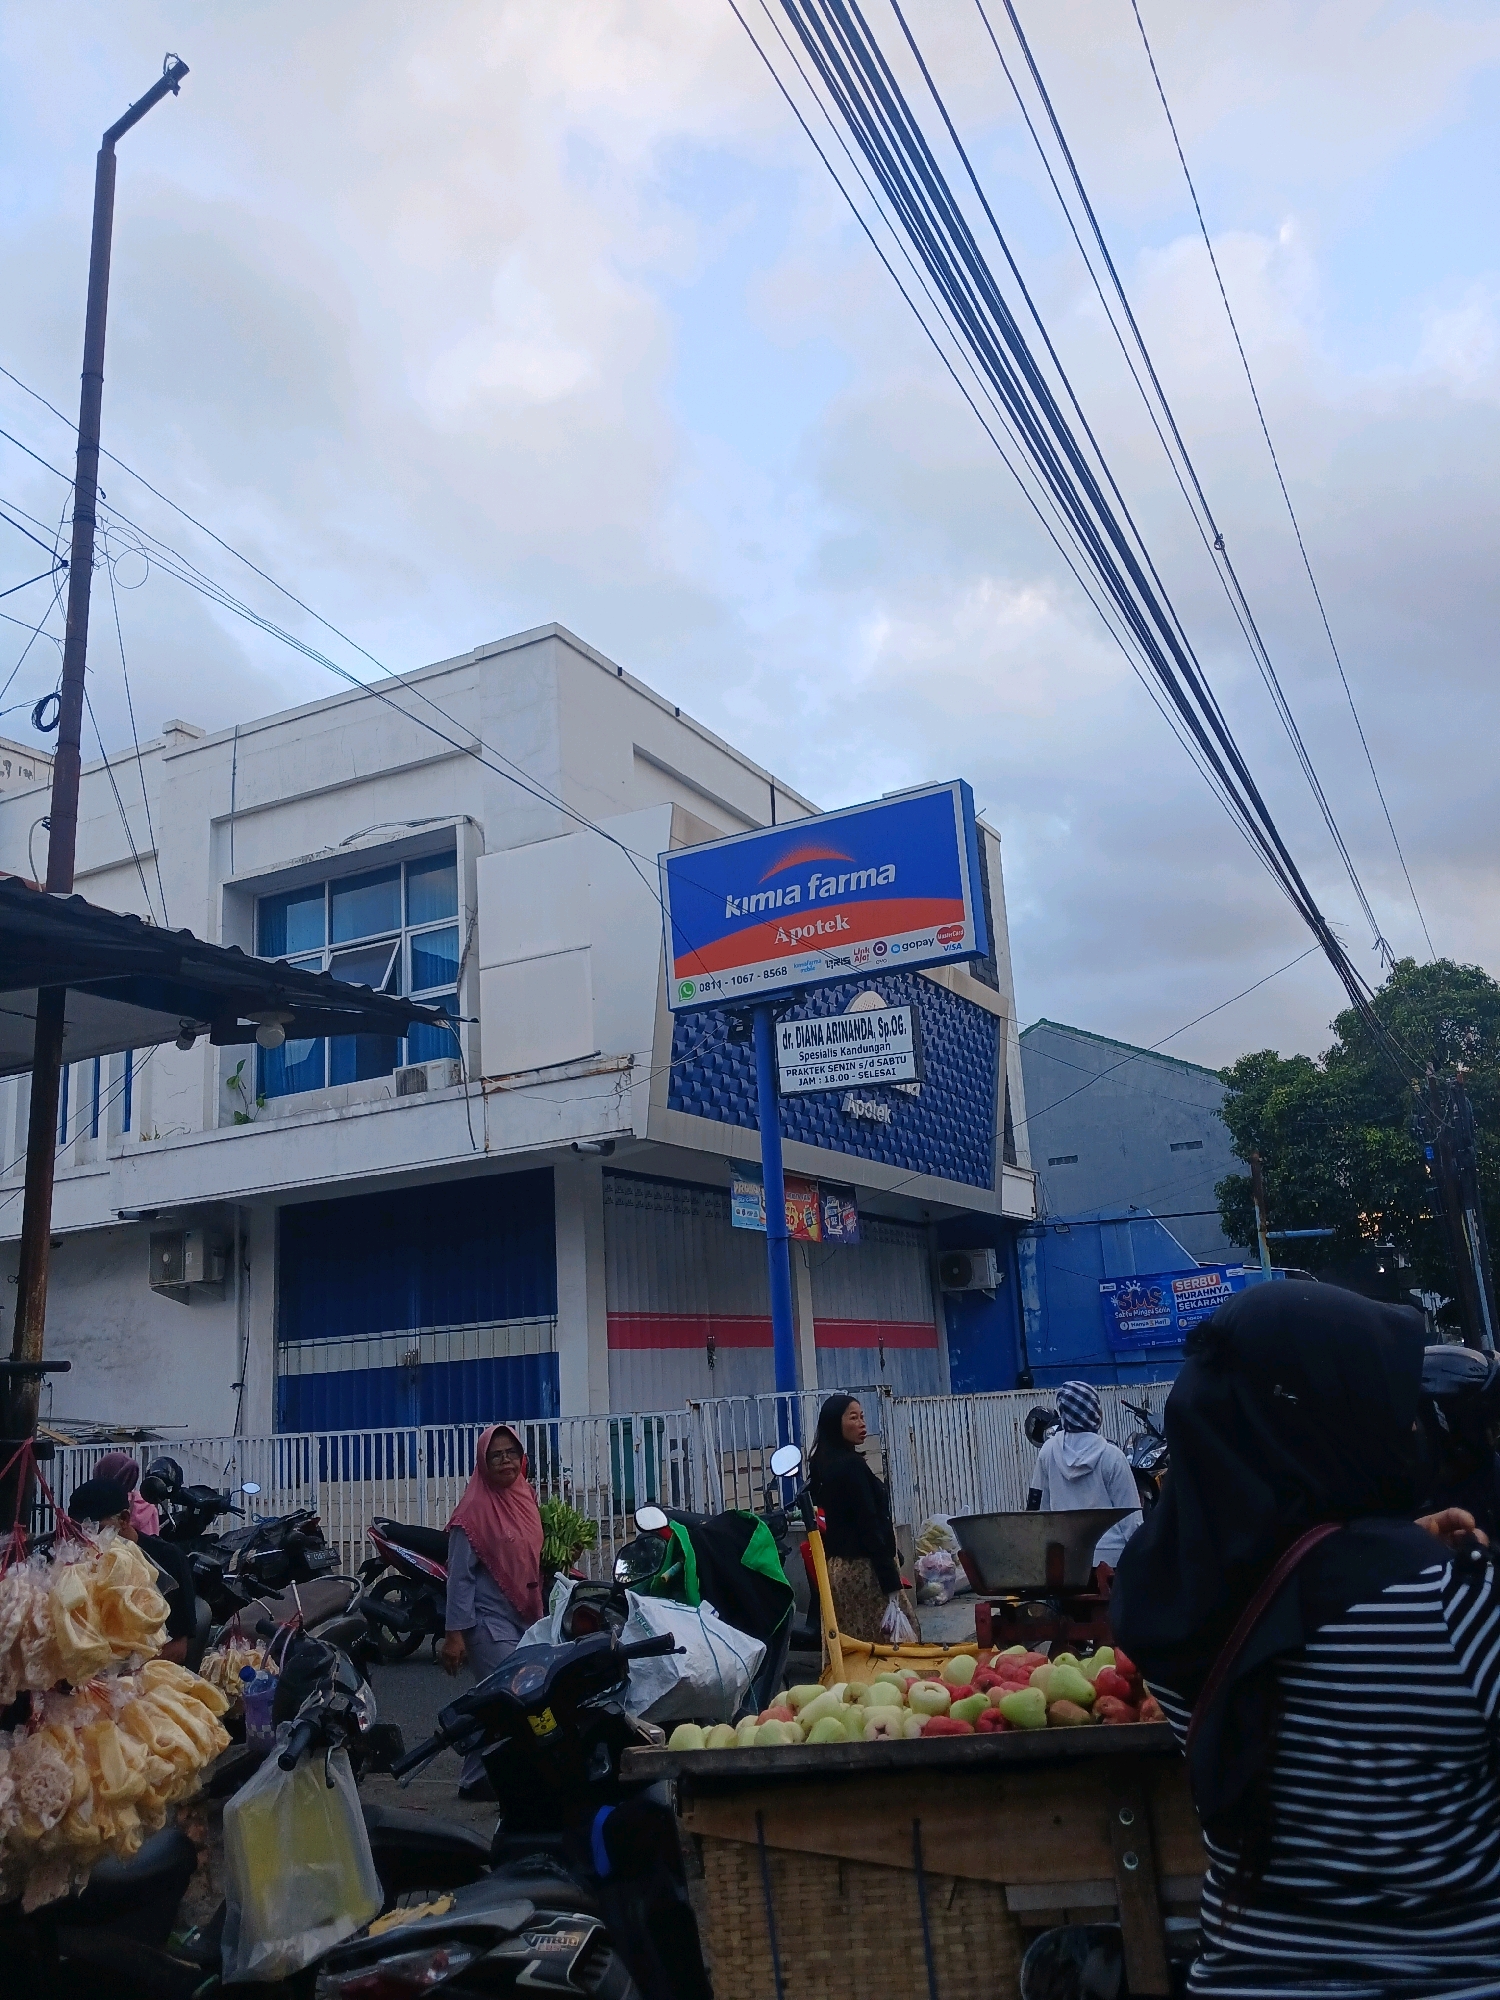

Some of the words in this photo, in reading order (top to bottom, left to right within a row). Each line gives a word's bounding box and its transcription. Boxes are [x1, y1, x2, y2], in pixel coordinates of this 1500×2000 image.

[808, 864, 896, 900] farma
[774, 914, 850, 946] Apotek
[901, 937, 935, 952] gopay
[943, 943, 963, 952] VISA
[699, 980, 721, 992] 0811
[731, 973, 754, 985] 1067
[763, 966, 788, 979] 8568
[782, 1027, 794, 1050] dr.
[795, 1022, 824, 1049] DIANA
[826, 1016, 876, 1046] ARINANDA,
[798, 1047, 838, 1062] Spesialis
[840, 1042, 891, 1057] Kandungan
[786, 1065, 826, 1077] PRAKTEK
[828, 1062, 856, 1073] SENIN
[858, 1058, 875, 1070] s/d
[876, 1055, 907, 1067] SABTU
[798, 1076, 816, 1086] JAM
[824, 1073, 850, 1084] 18.00
[857, 1067, 896, 1079] SELESAI
[841, 1092, 891, 1124] Apotek
[1175, 1274, 1217, 1291] SERBU
[1176, 1284, 1230, 1300] MURAHNYA
[1116, 1286, 1162, 1311] SMS
